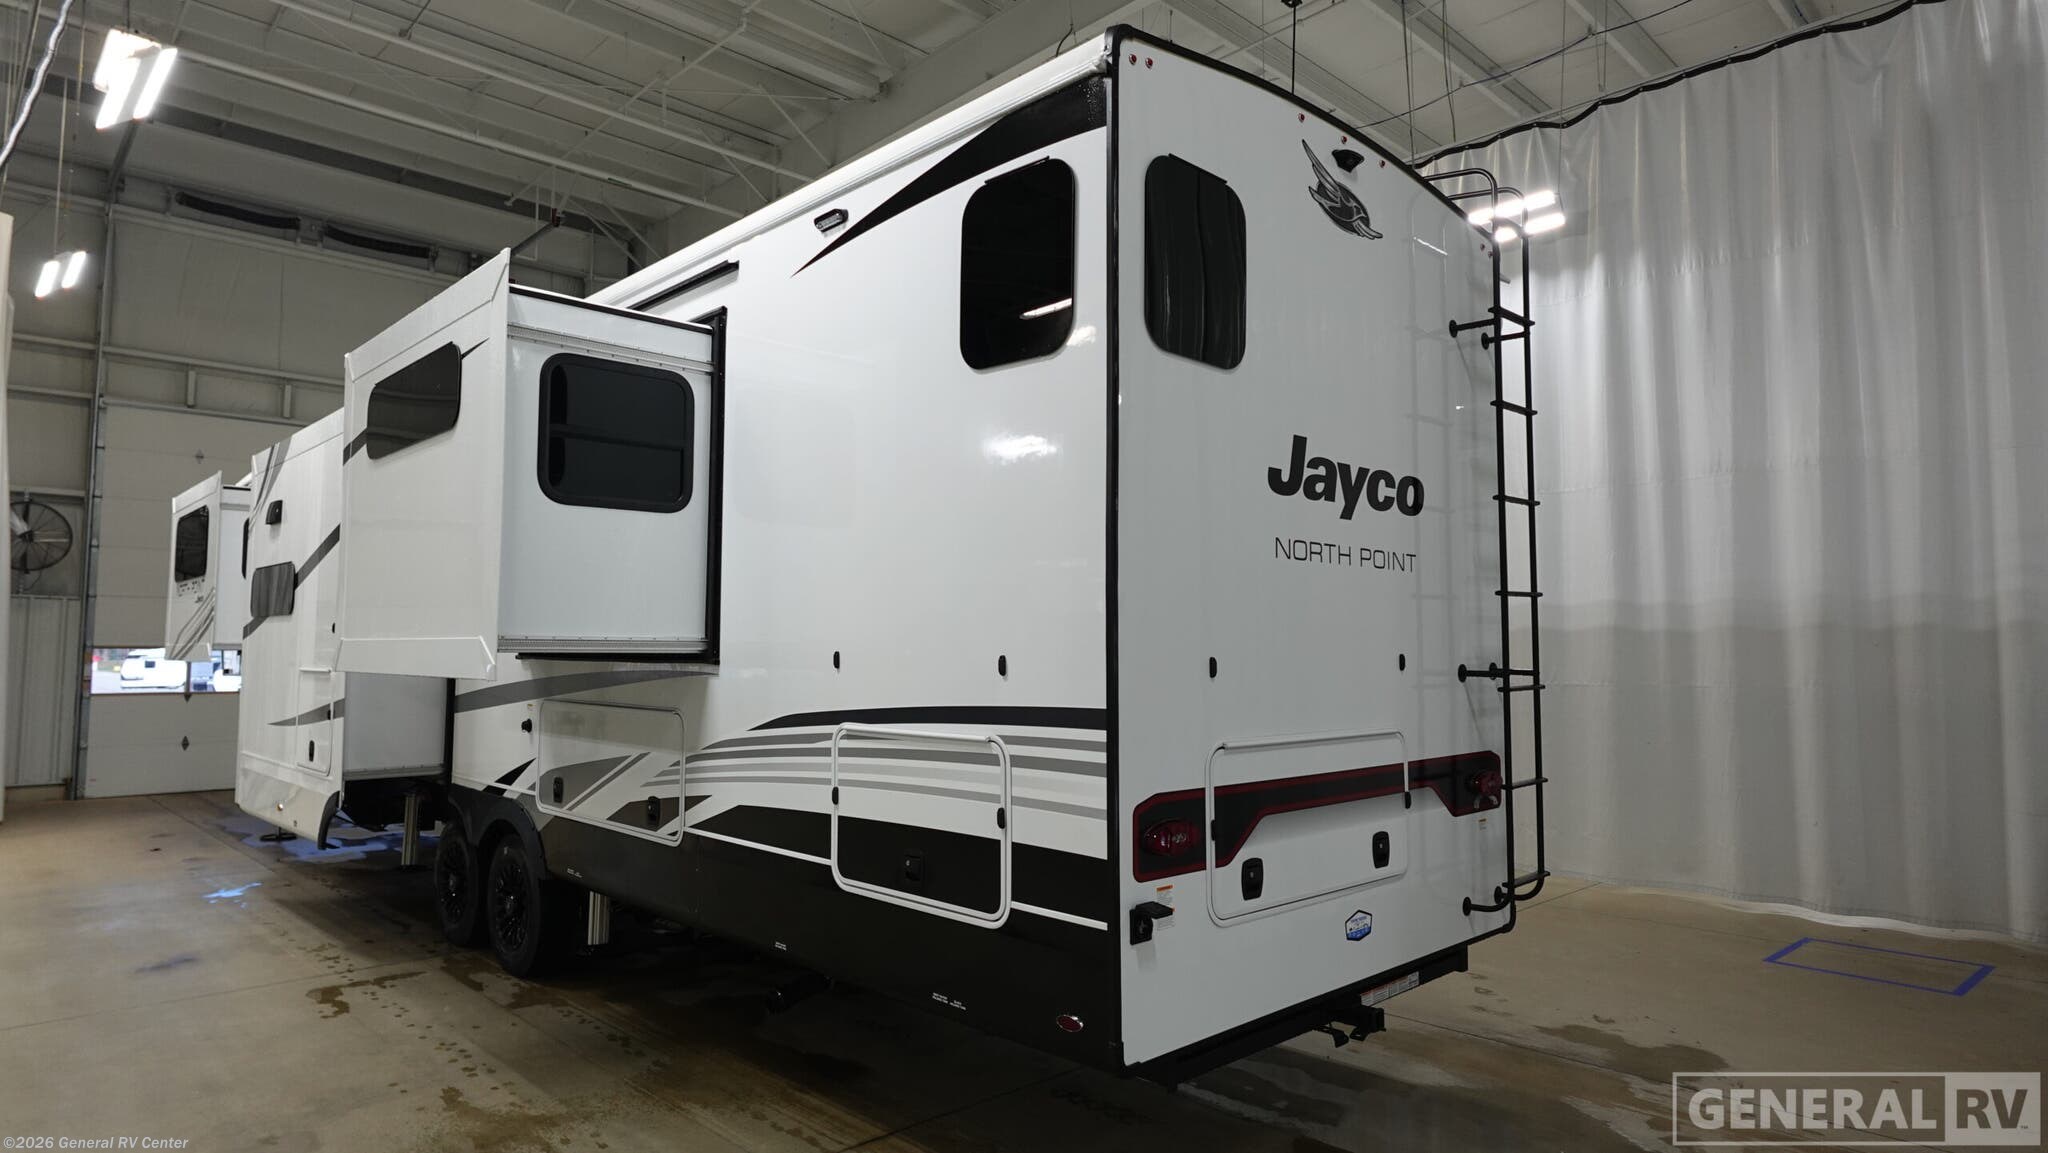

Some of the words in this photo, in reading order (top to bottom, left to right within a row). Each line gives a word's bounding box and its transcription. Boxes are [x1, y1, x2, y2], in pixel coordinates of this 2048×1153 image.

[1267, 434, 1425, 521] Jayco
[1275, 536, 1352, 566] NORTH
[1359, 547, 1417, 573] POINT
